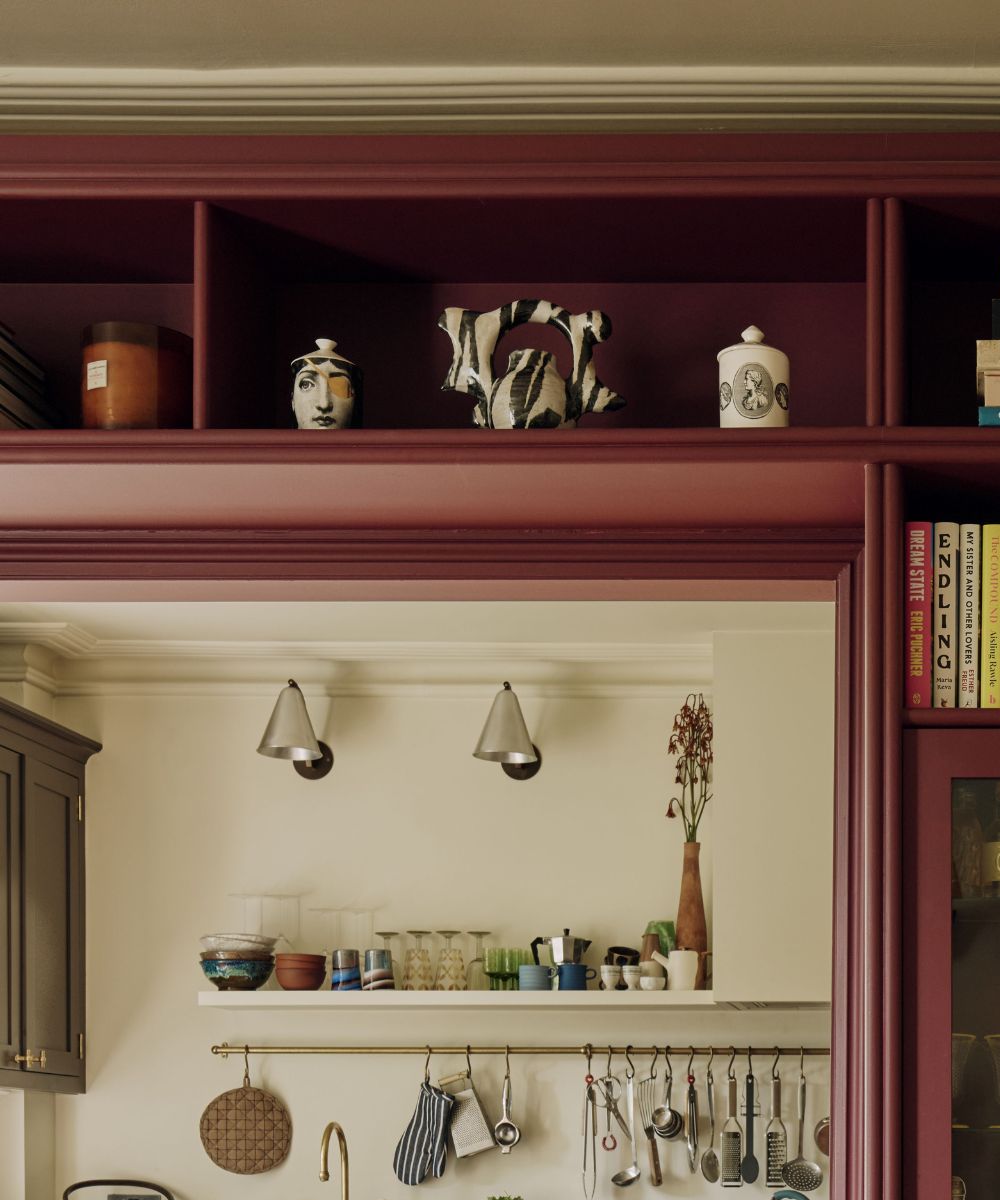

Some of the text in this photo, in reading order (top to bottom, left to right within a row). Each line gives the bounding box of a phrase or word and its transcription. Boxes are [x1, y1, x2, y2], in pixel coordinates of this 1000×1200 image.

[966, 532, 974, 544] MY
[910, 530, 924, 602] DREAM STATE
[966, 548, 974, 575] SISTER
[938, 534, 950, 669] ENDLING
[910, 610, 924, 676] ERIC PUCHNER
[988, 632, 997, 659] Aisling
